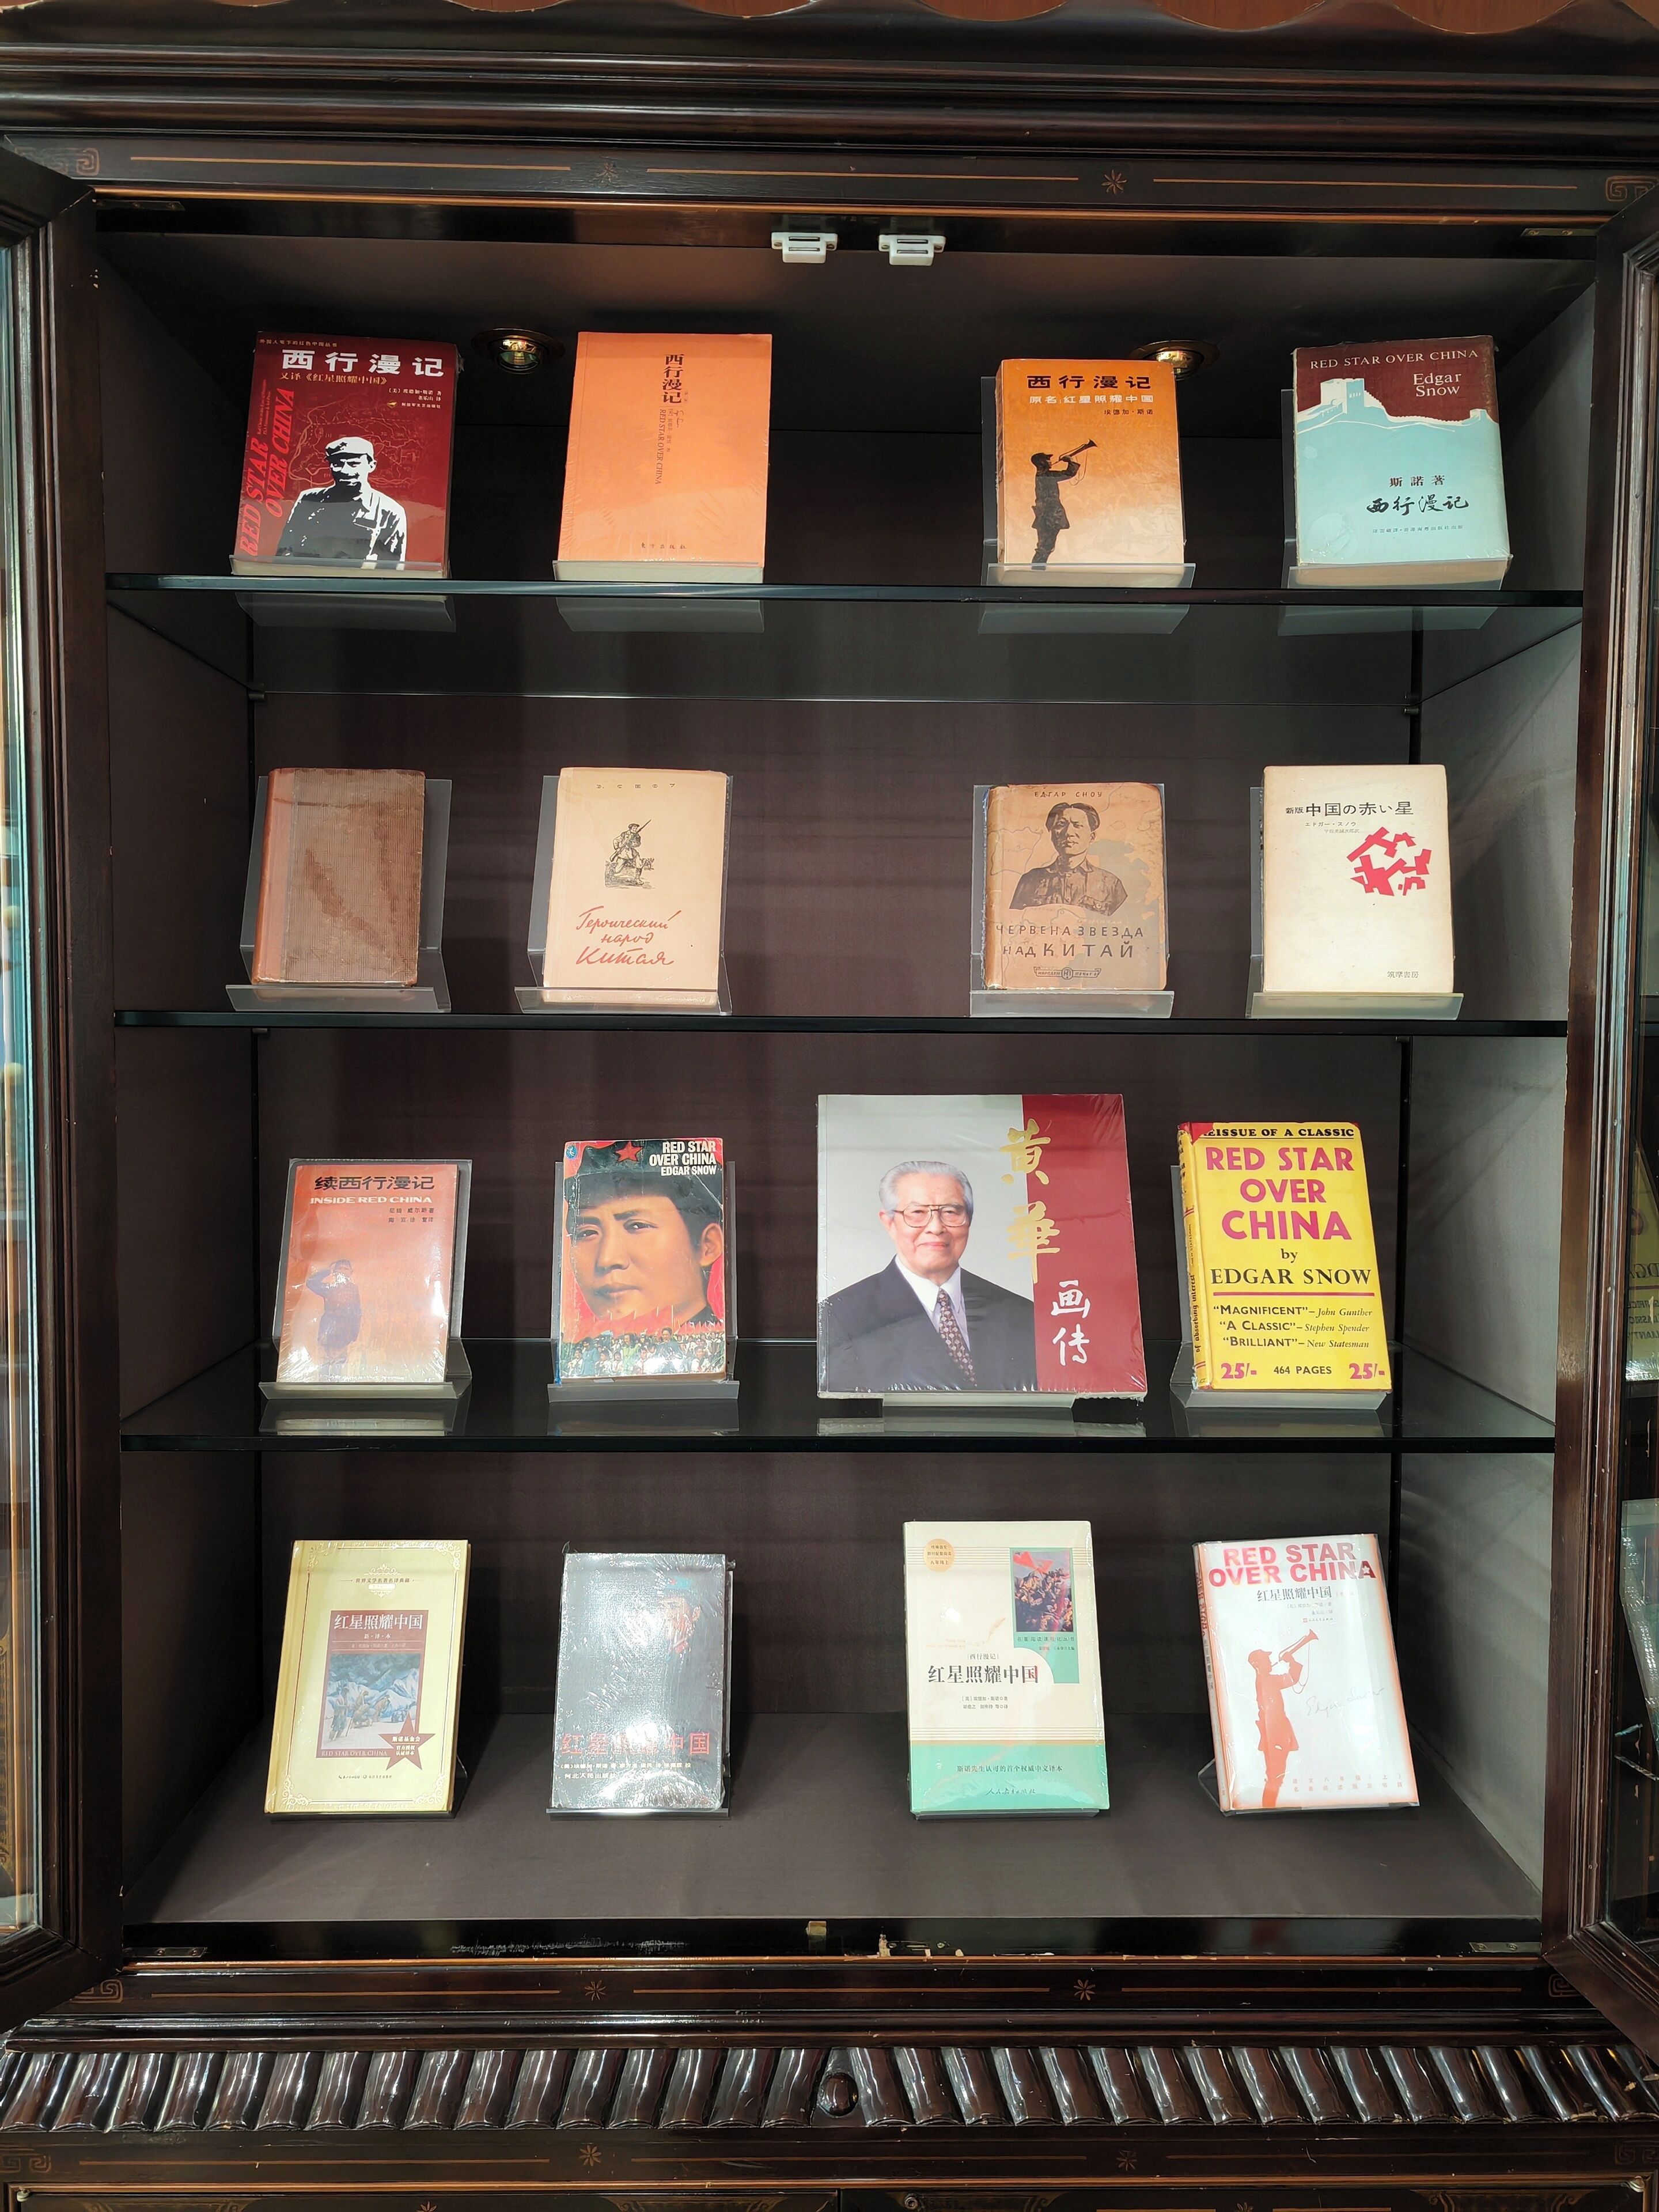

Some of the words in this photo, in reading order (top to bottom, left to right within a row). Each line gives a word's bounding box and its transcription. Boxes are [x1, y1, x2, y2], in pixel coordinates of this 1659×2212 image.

[282, 349, 444, 377] 西行漫记
[1310, 359, 1339, 369] RED
[1344, 355, 1381, 366] STAR
[1385, 353, 1425, 363] OVER
[1430, 350, 1478, 360] CHINA
[662, 354, 684, 403] 西行漫记
[1027, 375, 1152, 389] 西行漫记
[1413, 373, 1462, 387] Edgar
[1416, 385, 1460, 397] Snow
[272, 388, 294, 454] CHINA
[246, 437, 269, 503] STAR
[655, 463, 663, 484] CHINA
[266, 453, 287, 517] OVER
[240, 503, 261, 556] RED
[1306, 801, 1414, 816] 中国の赤い星
[576, 906, 681, 934] Героический
[601, 932, 654, 945] народ
[996, 925, 1071, 936] ЧЕРВЕНА
[1078, 926, 1143, 939] ЗВЕЗДА
[575, 946, 675, 965] Китая
[1003, 945, 1036, 958] НАД
[1043, 941, 1133, 958] КИТАЙ
[662, 1142, 685, 1153] RED
[688, 1141, 716, 1153] STAR
[649, 1154, 679, 1166] OVER
[681, 1153, 717, 1165] CHINA
[1206, 1147, 1265, 1171] RED
[1278, 1147, 1355, 1171] STAR
[661, 1166, 690, 1176] EDGAR
[691, 1165, 717, 1175] SNOW
[315, 1176, 435, 1190] 续西行漫记
[1240, 1179, 1327, 1203] OVER
[1221, 1210, 1353, 1240] CHINA
[1281, 1248, 1298, 1263] by
[1210, 1268, 1294, 1285] EDGAR
[1303, 1268, 1372, 1285] SNOW
[1316, 1308, 1335, 1318] John
[1339, 1308, 1372, 1316] Gunther
[1051, 1280, 1090, 1366] 画传
[1305, 1323, 1334, 1334] Stephen
[1338, 1323, 1369, 1335] Spender
[1307, 1339, 1325, 1347] New
[1329, 1339, 1369, 1348] Statesman
[1274, 1366, 1290, 1374] 464
[1296, 1365, 1332, 1374] PAGES
[1223, 1546, 1277, 1567] RED
[1286, 1541, 1357, 1563] STAR
[1209, 1566, 1282, 1587] OVER
[1290, 1560, 1376, 1583] CHINA
[1257, 1586, 1332, 1602] 红星照耀中国
[334, 1614, 423, 1630] 红星照耀中国
[928, 1665, 1038, 1684] 红星照耀中国
